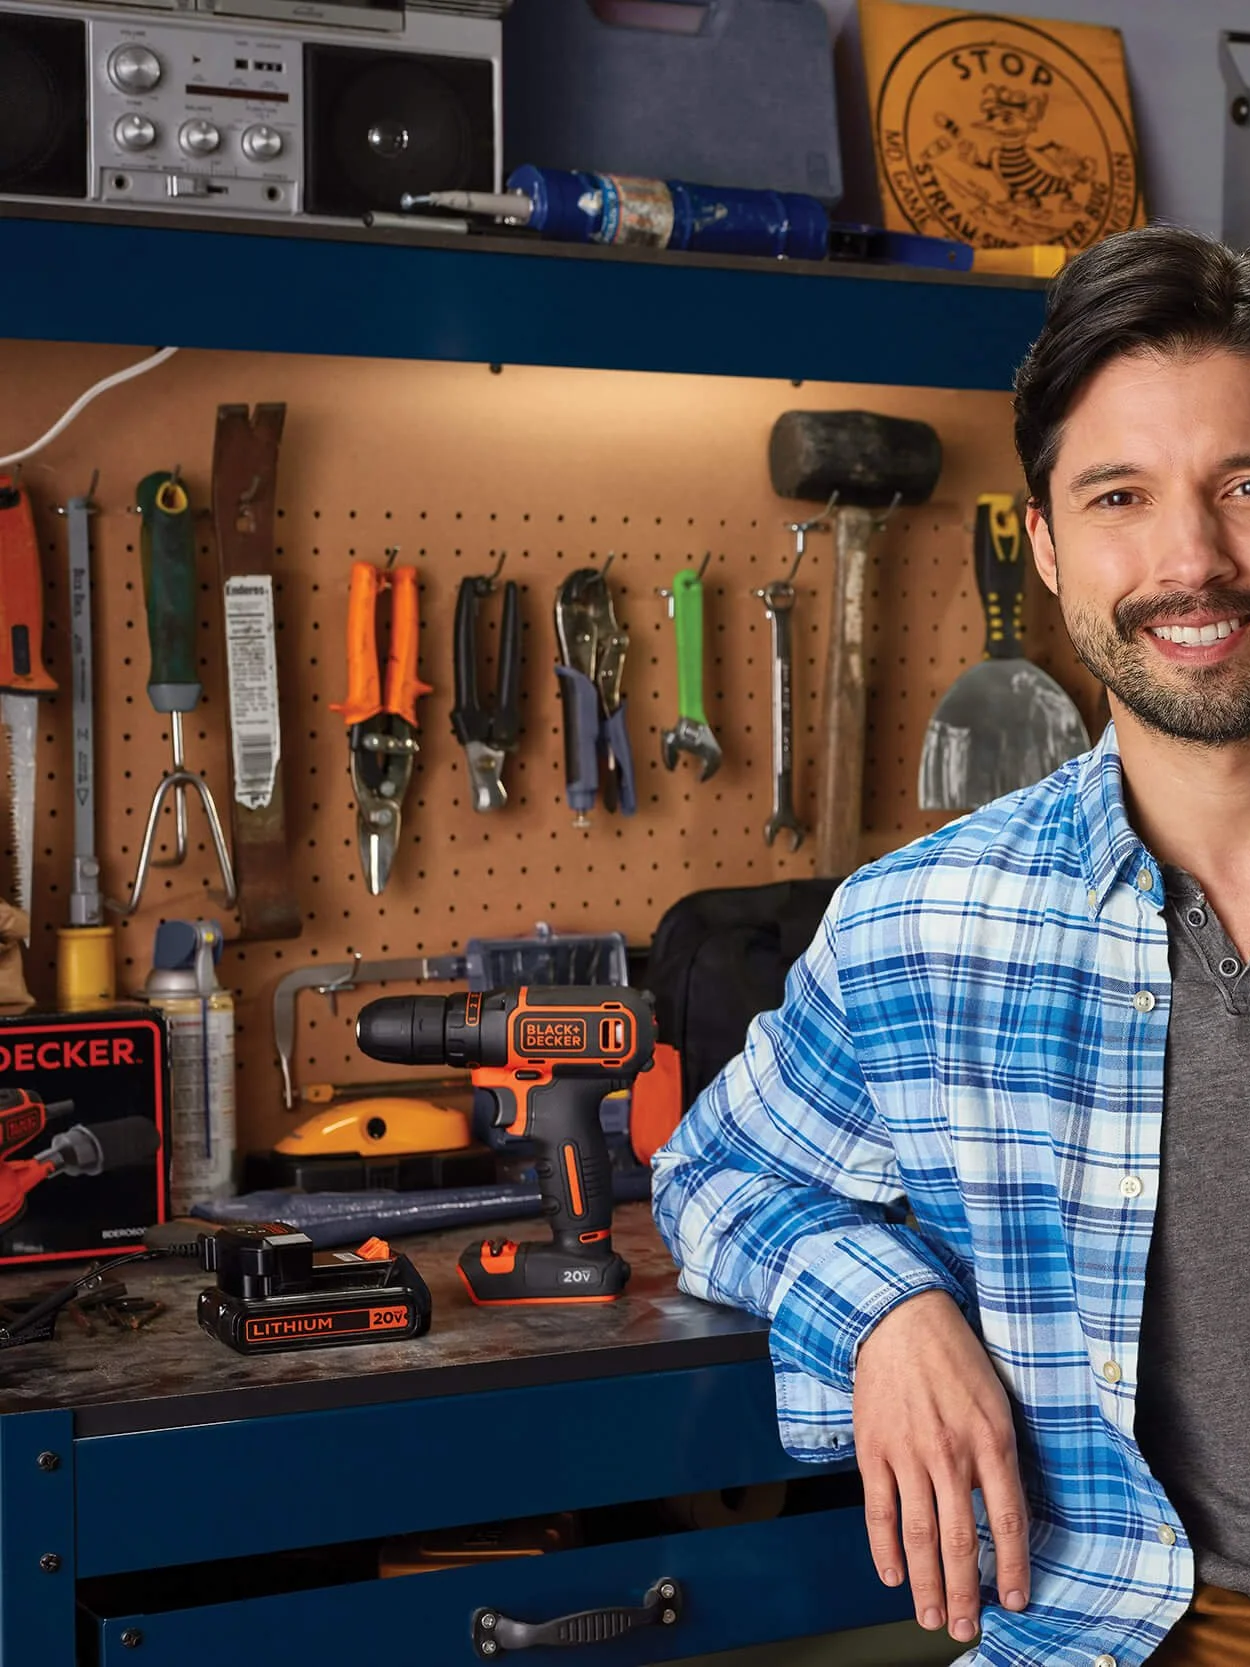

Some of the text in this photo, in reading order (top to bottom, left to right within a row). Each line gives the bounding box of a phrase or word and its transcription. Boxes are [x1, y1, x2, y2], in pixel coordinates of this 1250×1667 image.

[951, 49, 1054, 87] STOP
[915, 161, 979, 242] STREAM
[526, 1023, 581, 1036] BLACK+
[526, 1035, 582, 1047] DECKER
[563, 1270, 591, 1283] 20V
[253, 1311, 402, 1337] LITHIUM 20V
